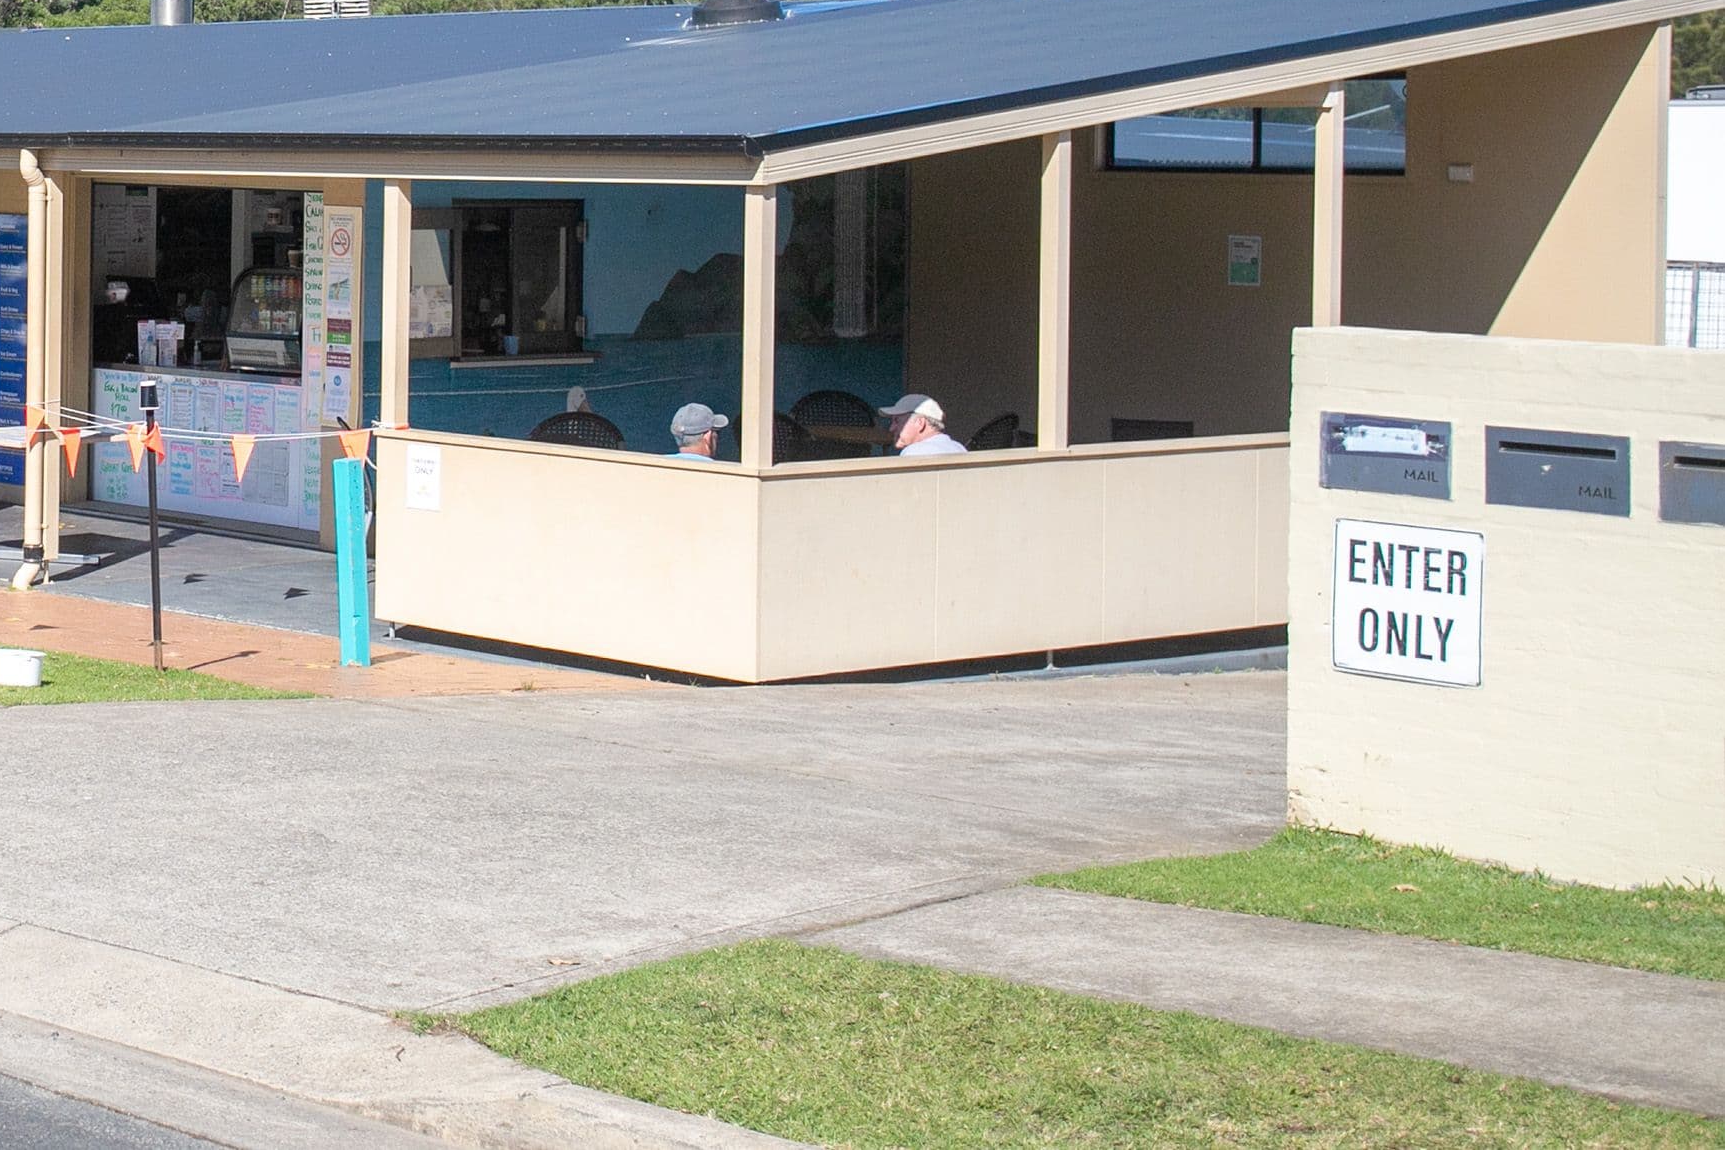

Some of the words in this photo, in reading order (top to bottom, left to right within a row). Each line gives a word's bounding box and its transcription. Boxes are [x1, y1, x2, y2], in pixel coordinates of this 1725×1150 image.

[1404, 468, 1440, 483] MAIL
[1578, 486, 1617, 500] MAIL
[1348, 538, 1468, 596] ENTER
[1358, 607, 1455, 662] ONLY
